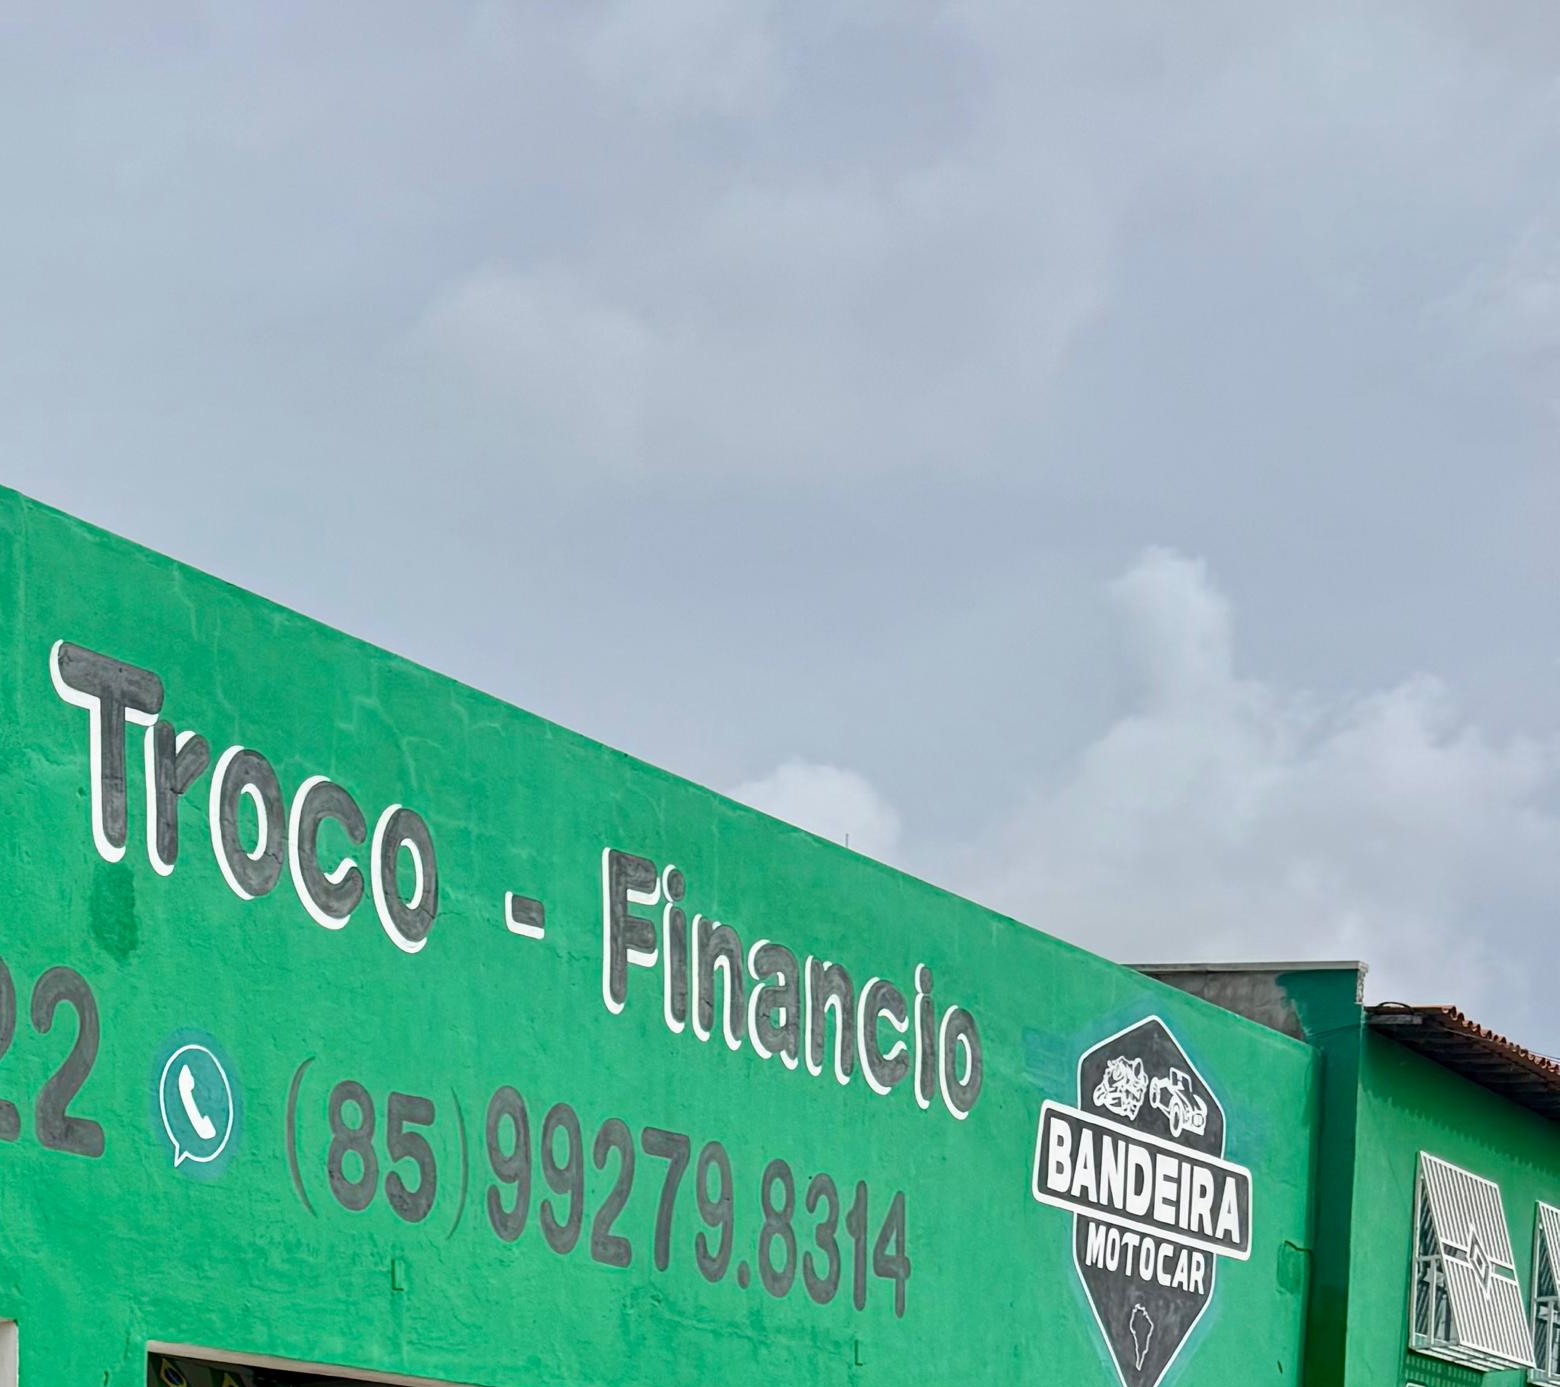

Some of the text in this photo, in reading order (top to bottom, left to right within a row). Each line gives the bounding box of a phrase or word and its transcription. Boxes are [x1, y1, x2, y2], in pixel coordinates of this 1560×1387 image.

[49, 638, 439, 953] Troco
[601, 847, 984, 1120] Financio
[1046, 1118, 1240, 1244] BANDEIRA
[1085, 1221, 1205, 1295] MOTOCAR
